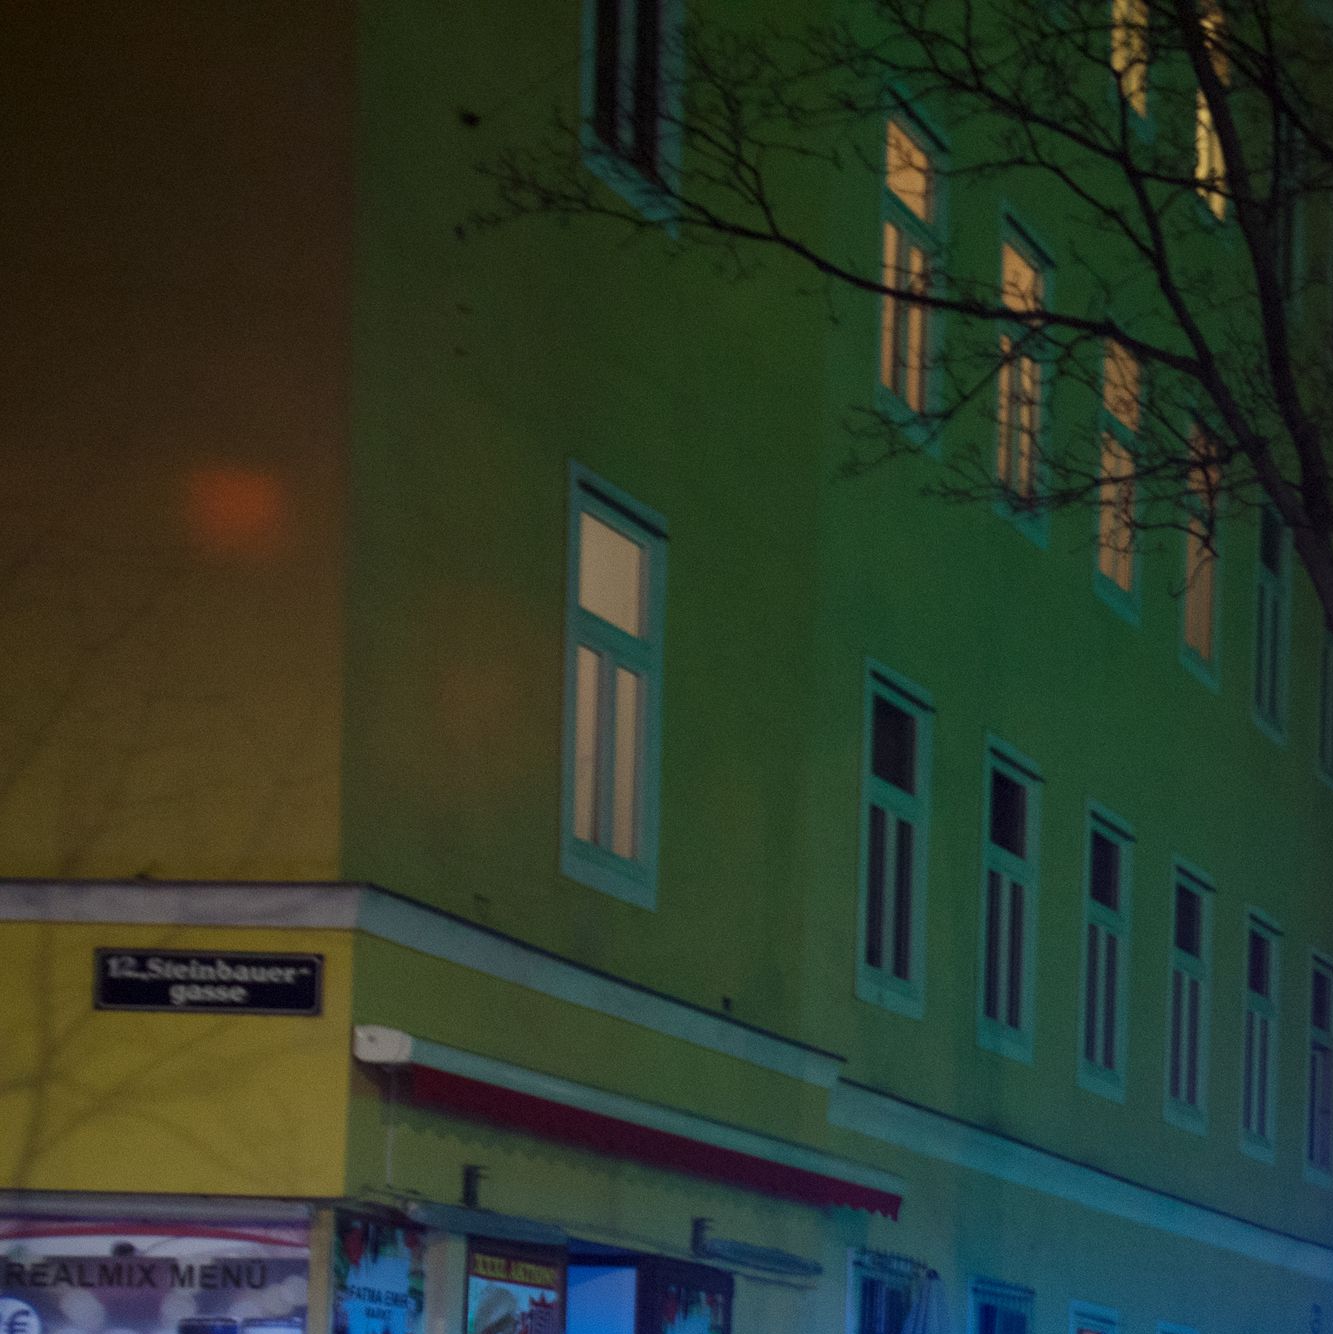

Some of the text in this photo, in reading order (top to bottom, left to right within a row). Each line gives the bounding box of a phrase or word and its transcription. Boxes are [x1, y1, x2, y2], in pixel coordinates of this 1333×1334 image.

[169, 985, 248, 1005] gasse
[5, 1263, 267, 1289] REALMIX MENÜ
